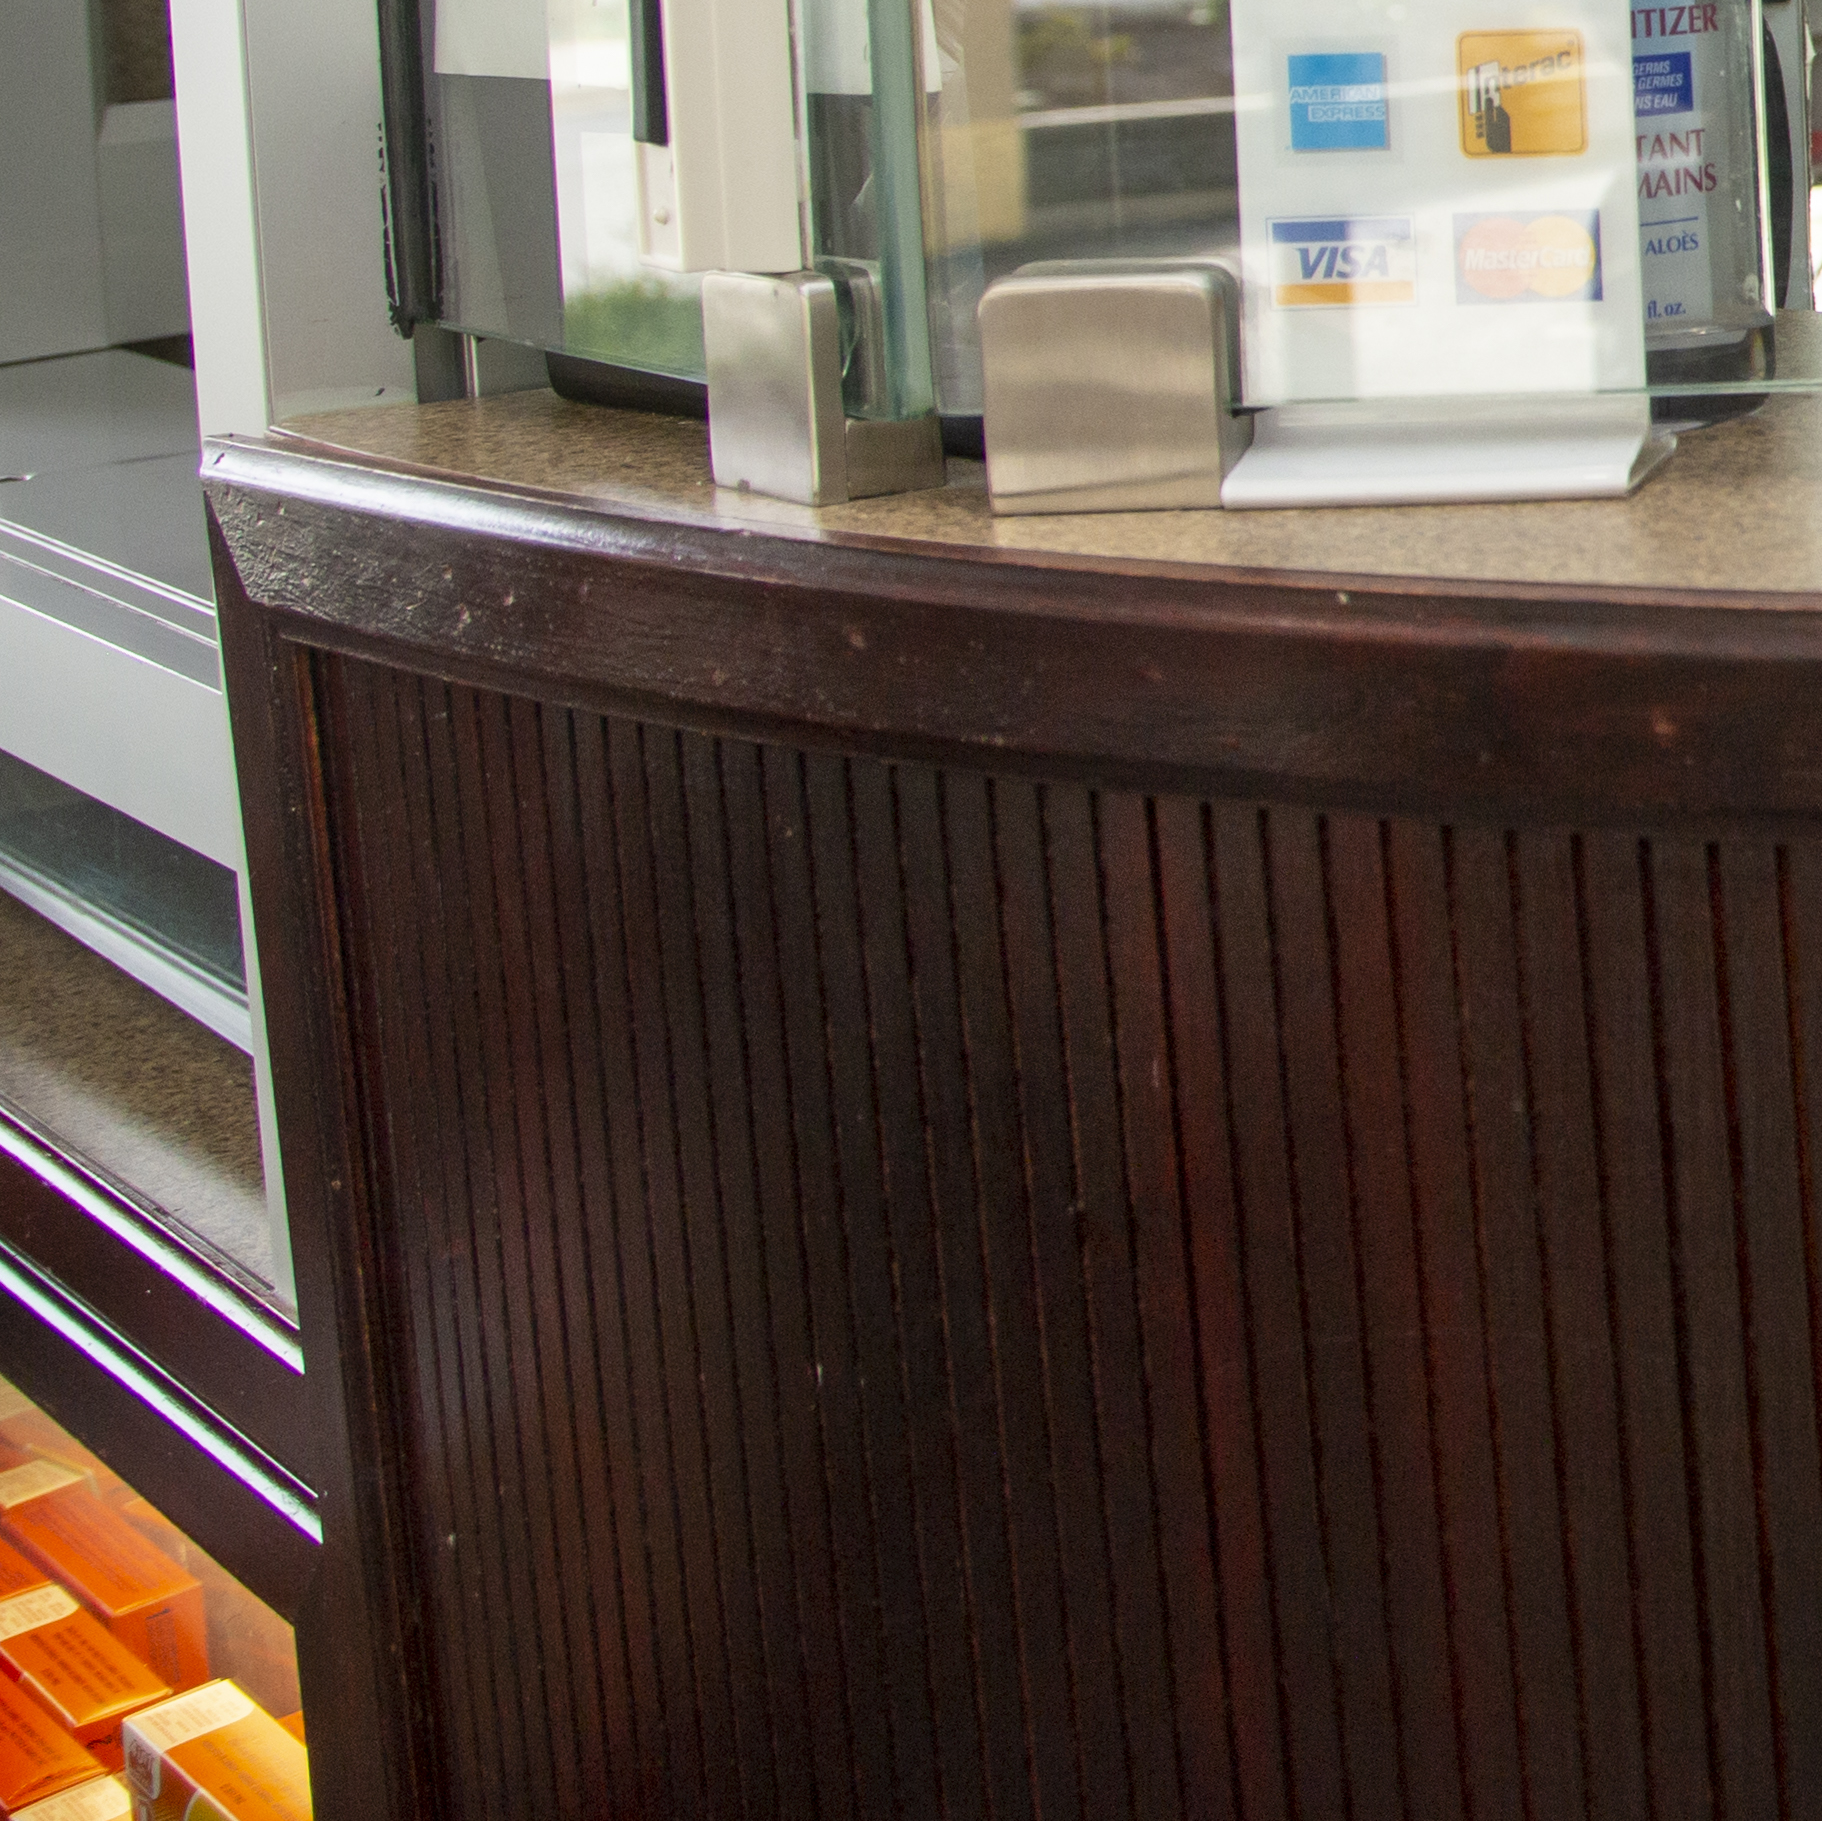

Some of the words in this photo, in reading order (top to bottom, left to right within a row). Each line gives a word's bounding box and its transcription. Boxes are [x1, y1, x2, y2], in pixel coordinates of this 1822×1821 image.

[1630, 3, 1720, 39] ITIZER
[1632, 60, 1670, 77] GERMS
[1290, 84, 1382, 104] AMERICAN
[1653, 92, 1678, 108] EAU
[1309, 104, 1386, 122] EXPRESS
[1645, 232, 1699, 257] ALOÈS
[1295, 245, 1390, 280] VISA
[1464, 245, 1592, 272] MasterCard
[1664, 300, 1687, 318] oz.
